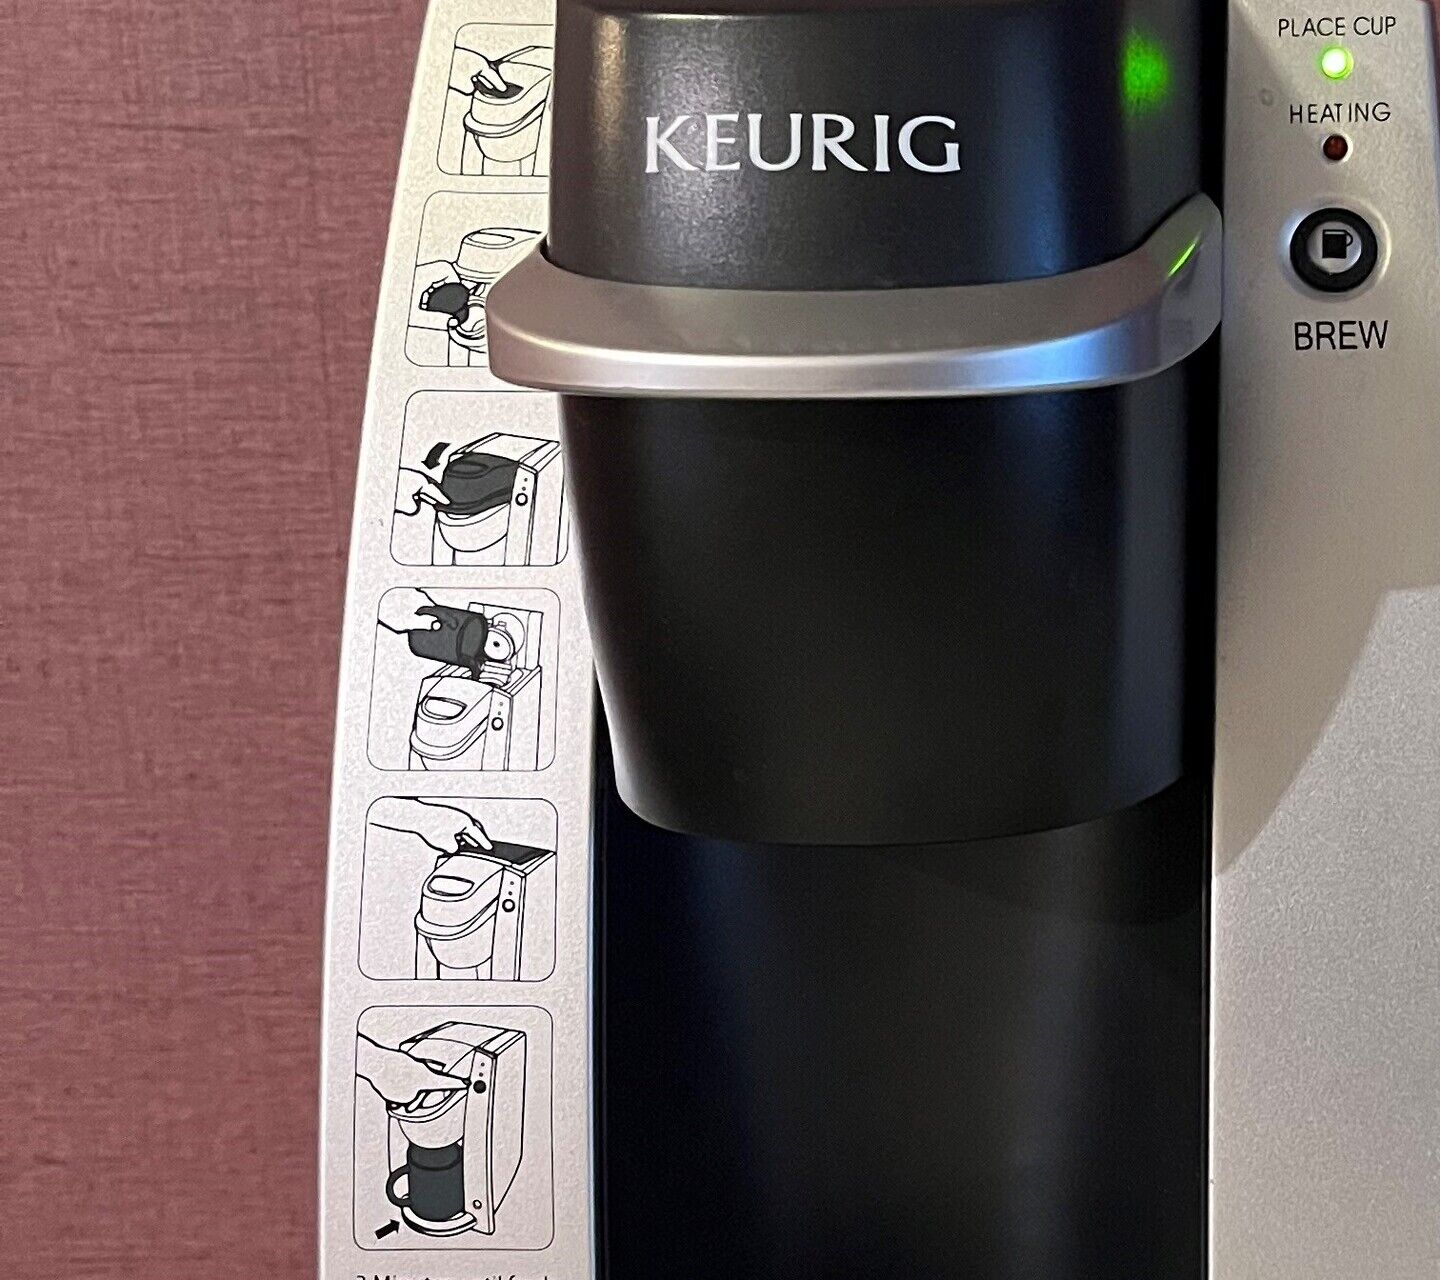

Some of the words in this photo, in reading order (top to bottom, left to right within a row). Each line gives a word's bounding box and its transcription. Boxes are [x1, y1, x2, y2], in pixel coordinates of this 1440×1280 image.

[1278, 17, 1346, 38] PLACE
[1352, 15, 1397, 37] CUP
[1289, 101, 1392, 124] HEATING
[644, 111, 962, 175] KEURIG
[1294, 320, 1389, 351] BREW
